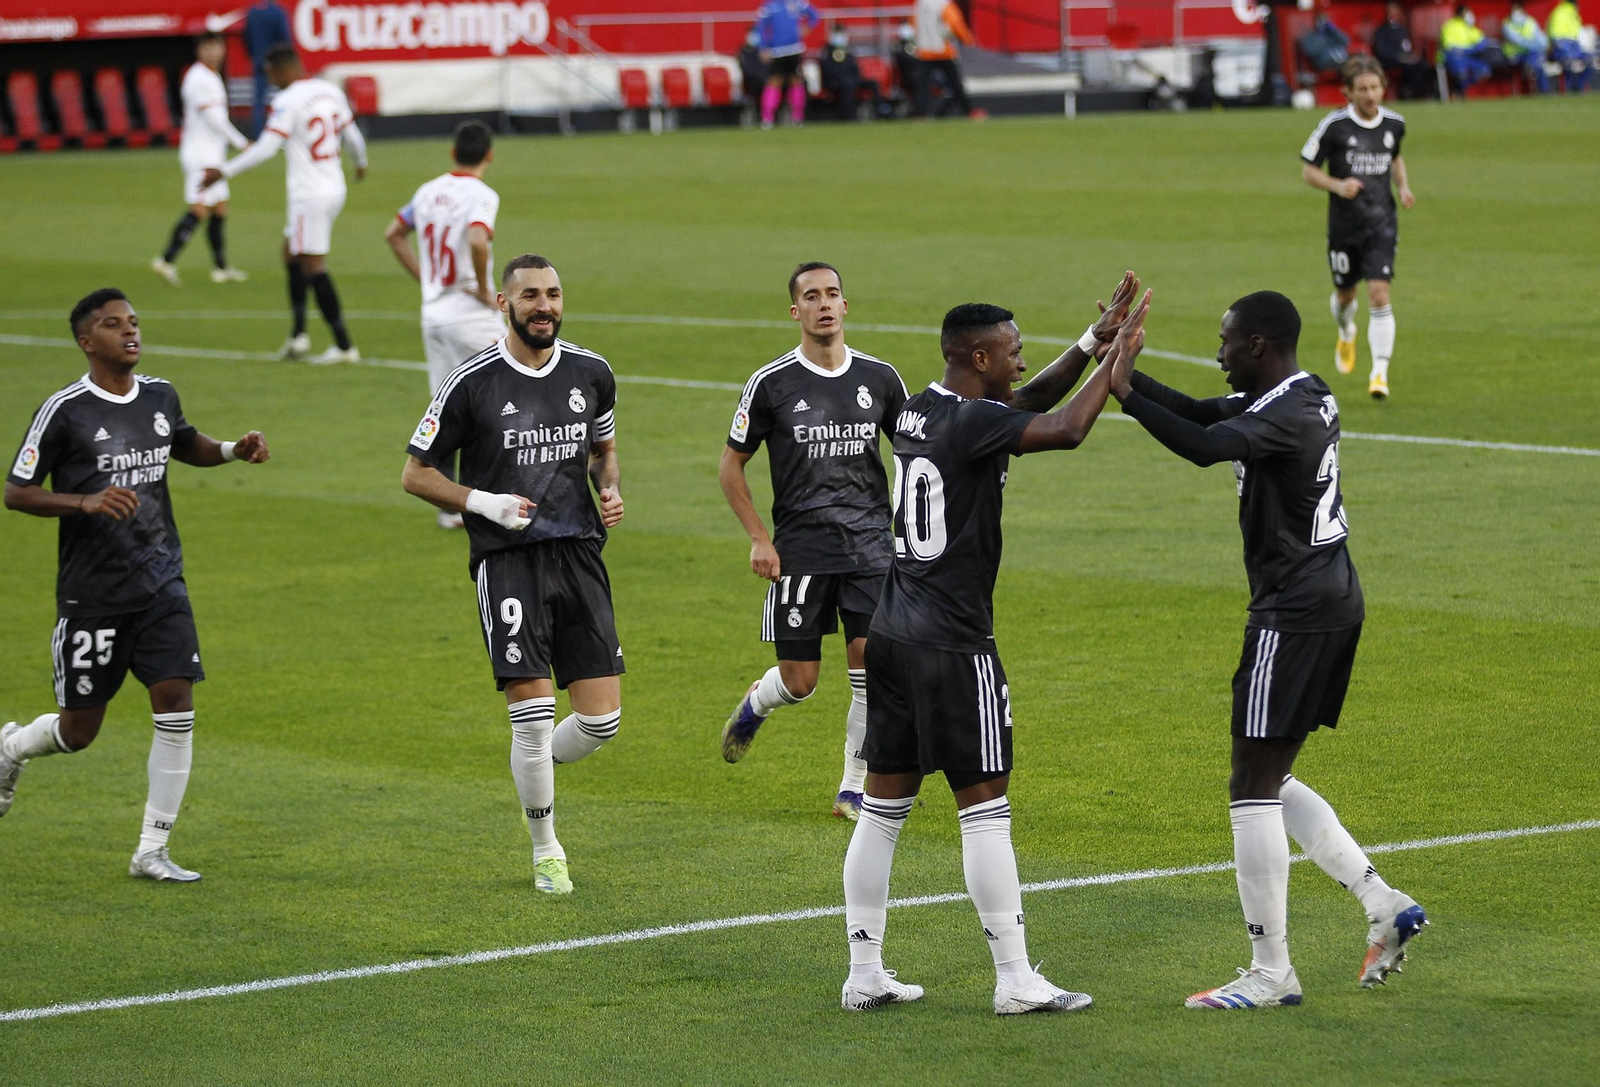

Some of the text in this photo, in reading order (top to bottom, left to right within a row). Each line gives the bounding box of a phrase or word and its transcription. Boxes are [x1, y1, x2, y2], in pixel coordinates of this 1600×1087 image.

[293, 0, 549, 56] Cruzcampo
[423, 223, 456, 288] 16
[1330, 250, 1350, 274] 10
[503, 422, 587, 449] Emirates
[793, 420, 876, 444] Emirates
[540, 442, 579, 463] BETTER
[1311, 441, 1349, 546] 2
[779, 575, 812, 605] 17
[500, 597, 523, 637] 9
[72, 628, 116, 669] 25
